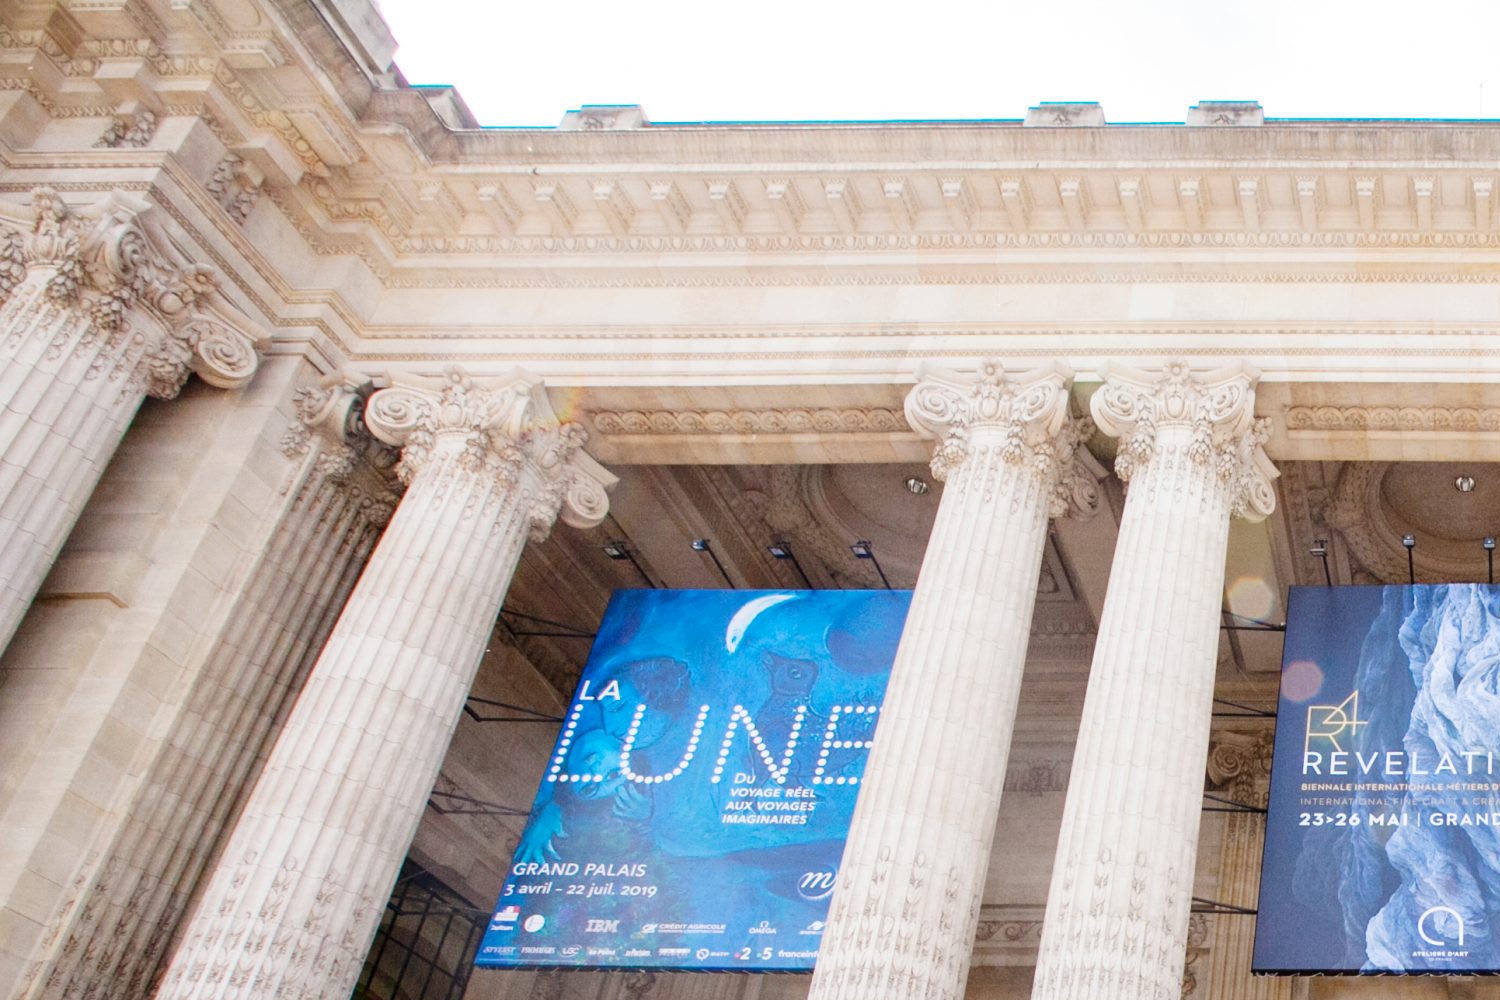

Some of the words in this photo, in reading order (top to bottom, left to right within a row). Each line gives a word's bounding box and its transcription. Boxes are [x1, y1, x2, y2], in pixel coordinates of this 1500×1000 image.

[579, 680, 622, 701] LA
[547, 703, 884, 784] LUNE
[730, 788, 781, 798] VOYAGE
[785, 786, 816, 798] RÉEL
[1301, 783, 1352, 791] BIENNALE
[1355, 783, 1443, 791] INTERNATIONALE
[1447, 781, 1489, 791] MÉTIERS
[725, 801, 752, 811] AUX
[756, 801, 816, 811] VOYAGES
[722, 814, 808, 825] IMAGINAIRES
[1369, 812, 1408, 826] MAI
[513, 862, 580, 876] GRAND
[584, 863, 648, 877] PALAIS
[504, 884, 516, 897] 3
[518, 882, 552, 895] avril
[566, 884, 585, 895] 22
[586, 883, 615, 898] juil.
[620, 885, 658, 898] 2019
[585, 919, 620, 933] IBM
[749, 927, 777, 935] OMEGA
[778, 950, 820, 958] franceinf
